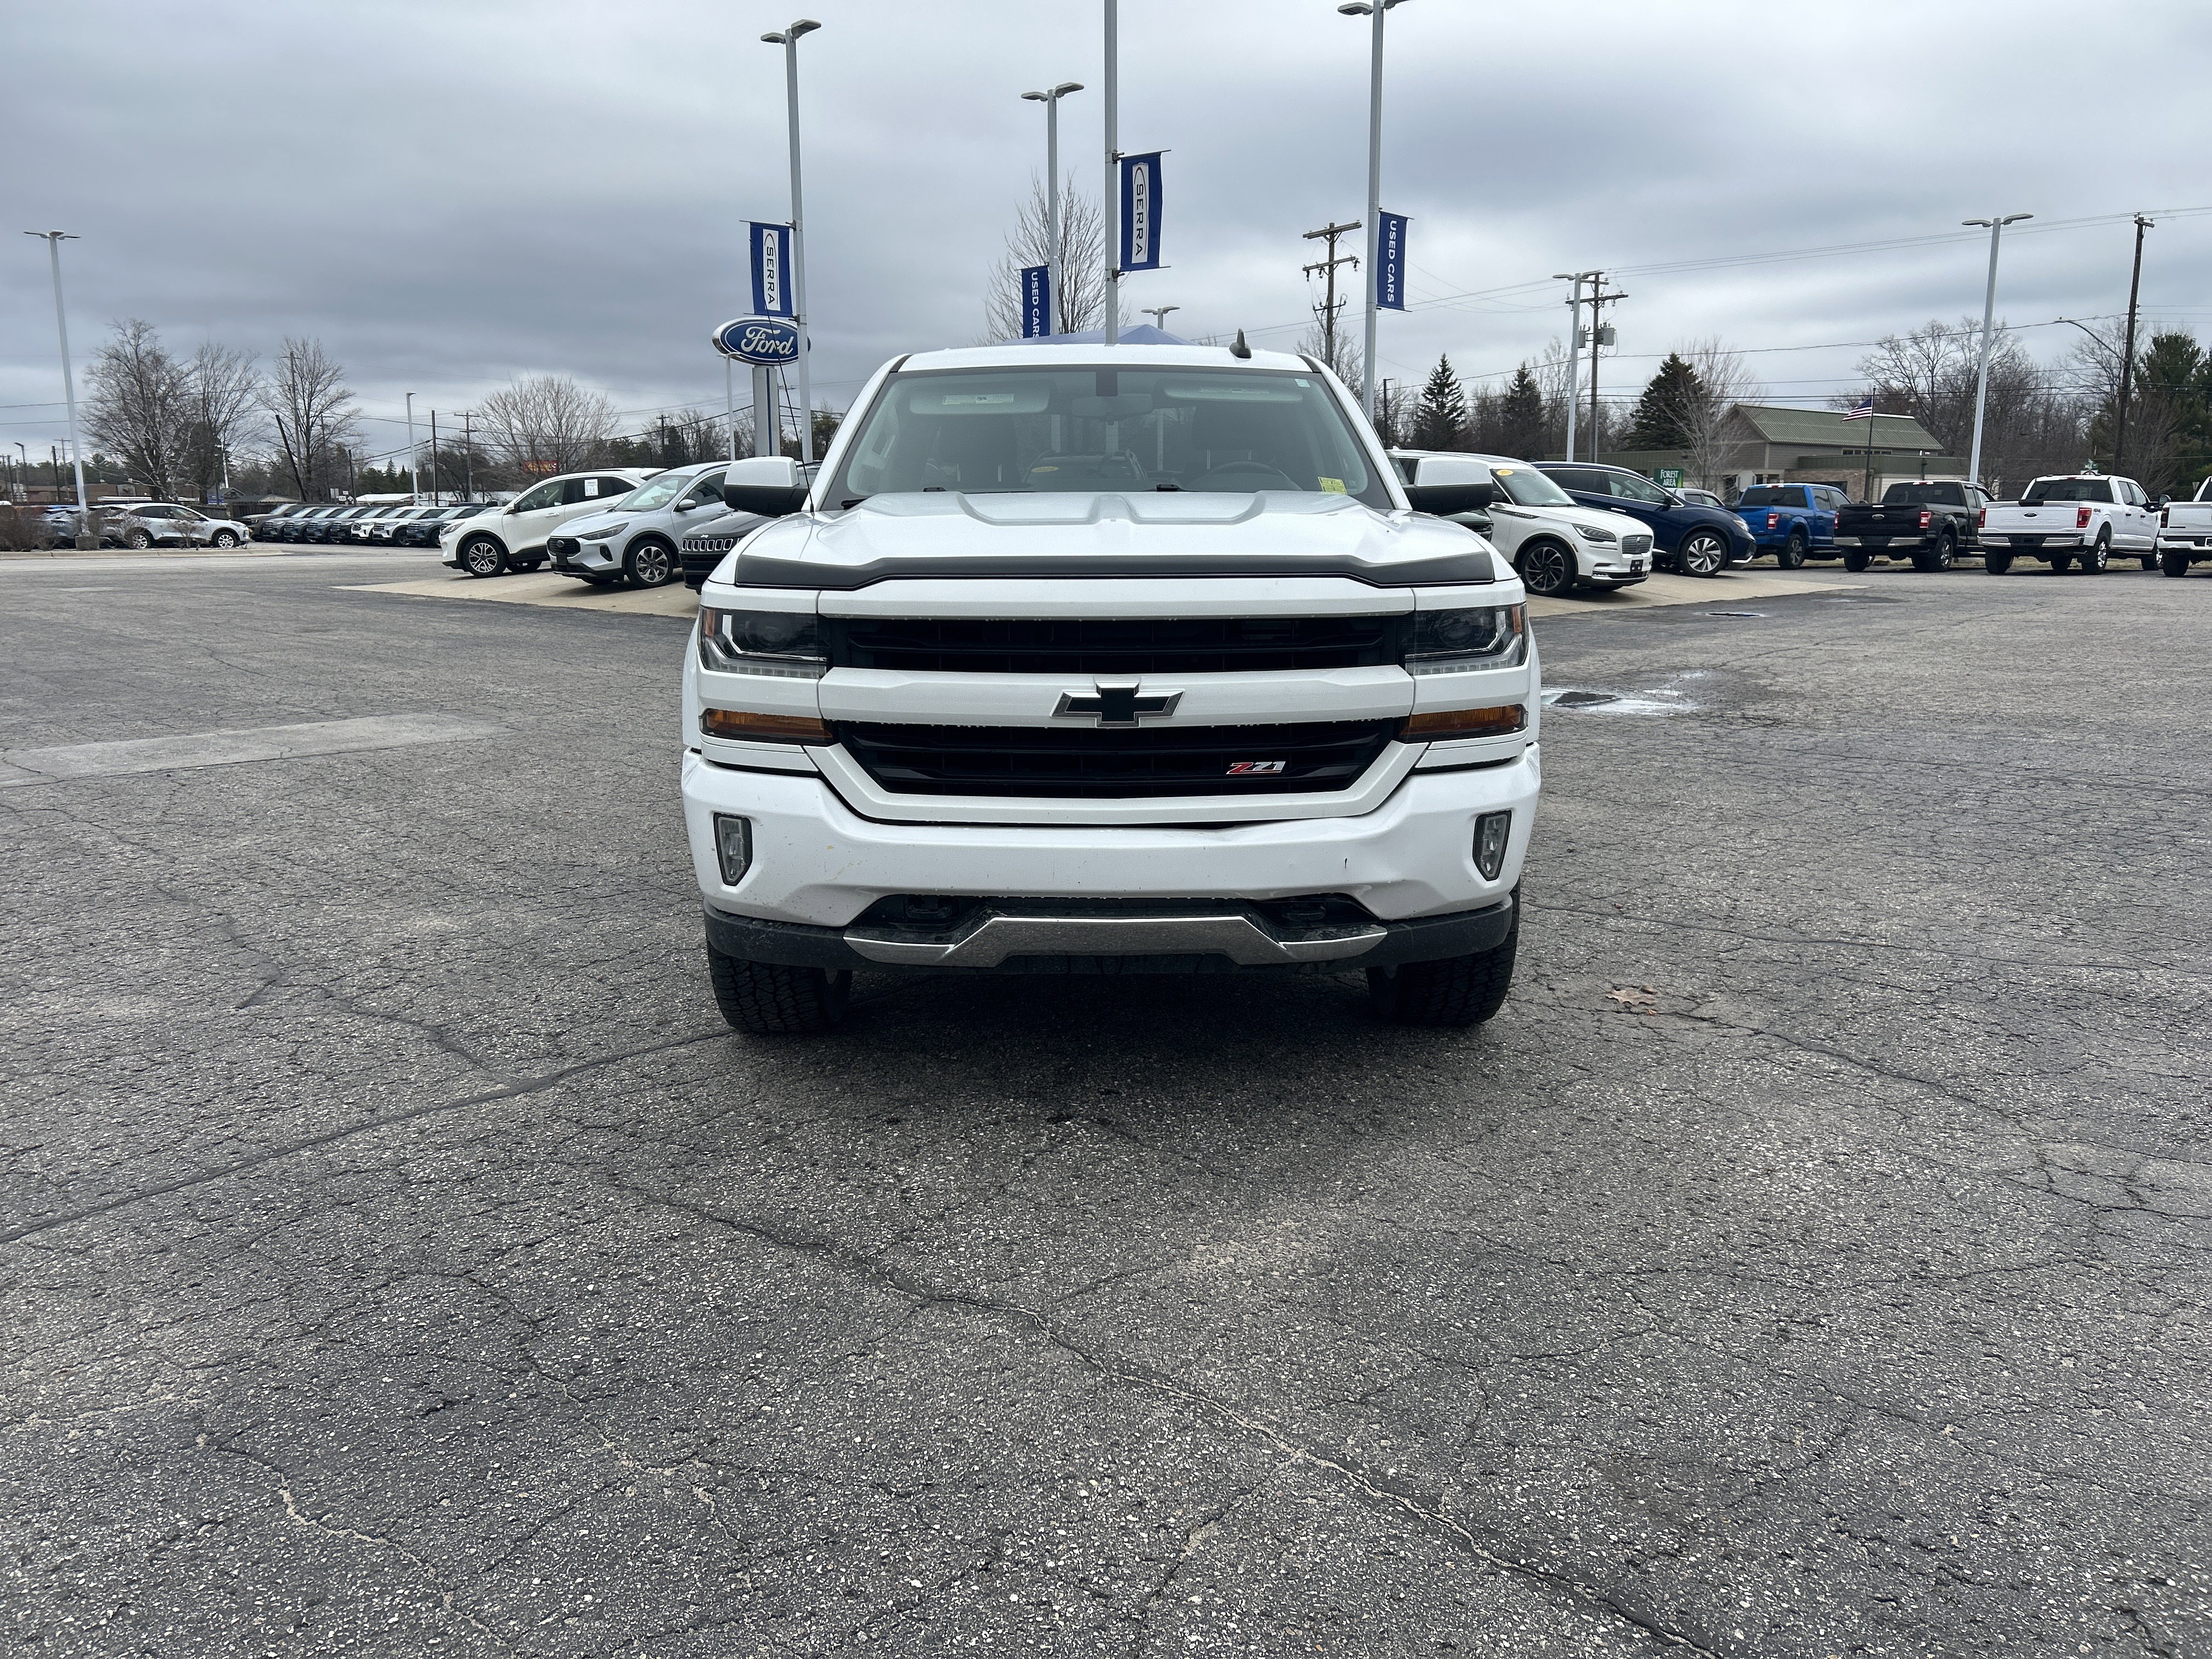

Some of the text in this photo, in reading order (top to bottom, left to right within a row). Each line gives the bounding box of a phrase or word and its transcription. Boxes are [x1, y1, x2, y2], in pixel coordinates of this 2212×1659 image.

[1135, 183, 1144, 257] SERRA
[766, 246, 776, 304] SERRA
[1387, 220, 1397, 302] USED CARS
[1031, 272, 1040, 304] USED
[741, 326, 794, 356] Ford
[1660, 469, 1679, 479] FOREST
[1662, 478, 1676, 487] AREA
[1226, 761, 1286, 775] Z71
